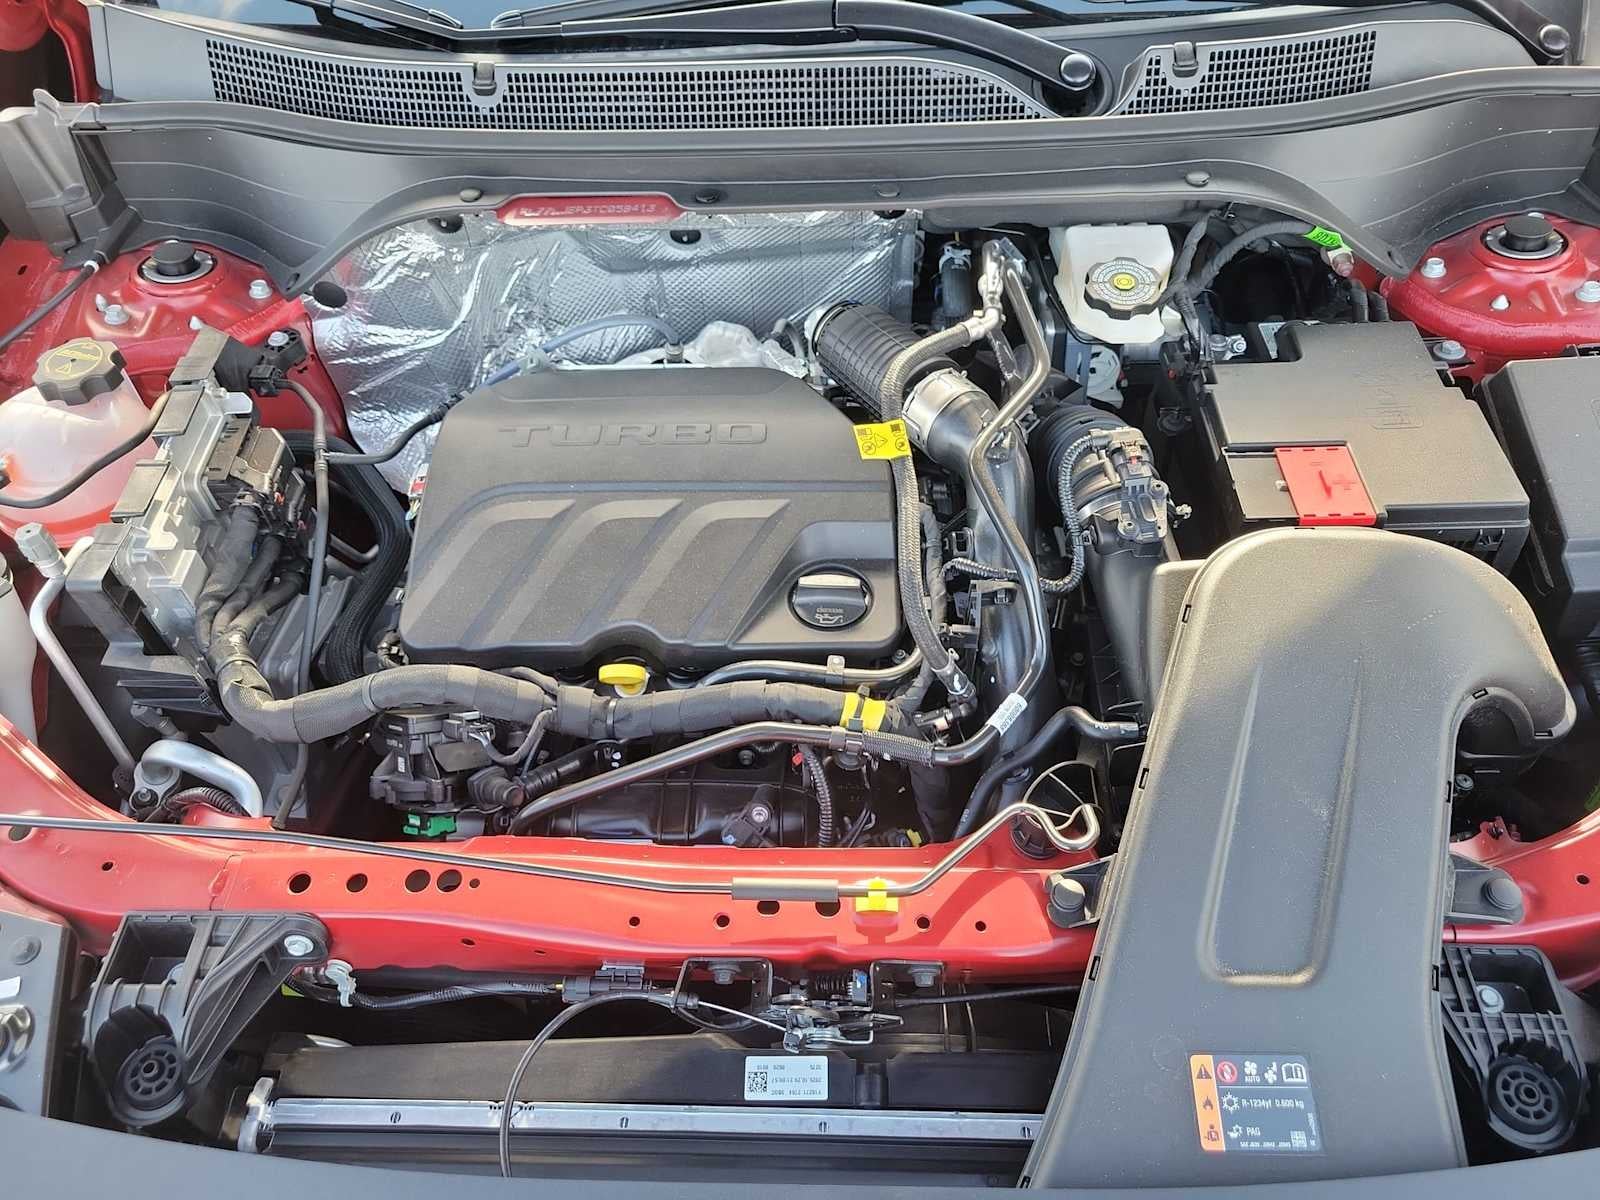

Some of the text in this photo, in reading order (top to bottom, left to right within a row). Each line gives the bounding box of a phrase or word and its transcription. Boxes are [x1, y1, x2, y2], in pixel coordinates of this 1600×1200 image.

[498, 423, 768, 448] TURBO
[1245, 1075, 1260, 1083] AUTO
[1241, 1098, 1272, 1110] R-1234yf
[1295, 1098, 1305, 1110] kg
[1246, 1126, 1261, 1137] PAG
